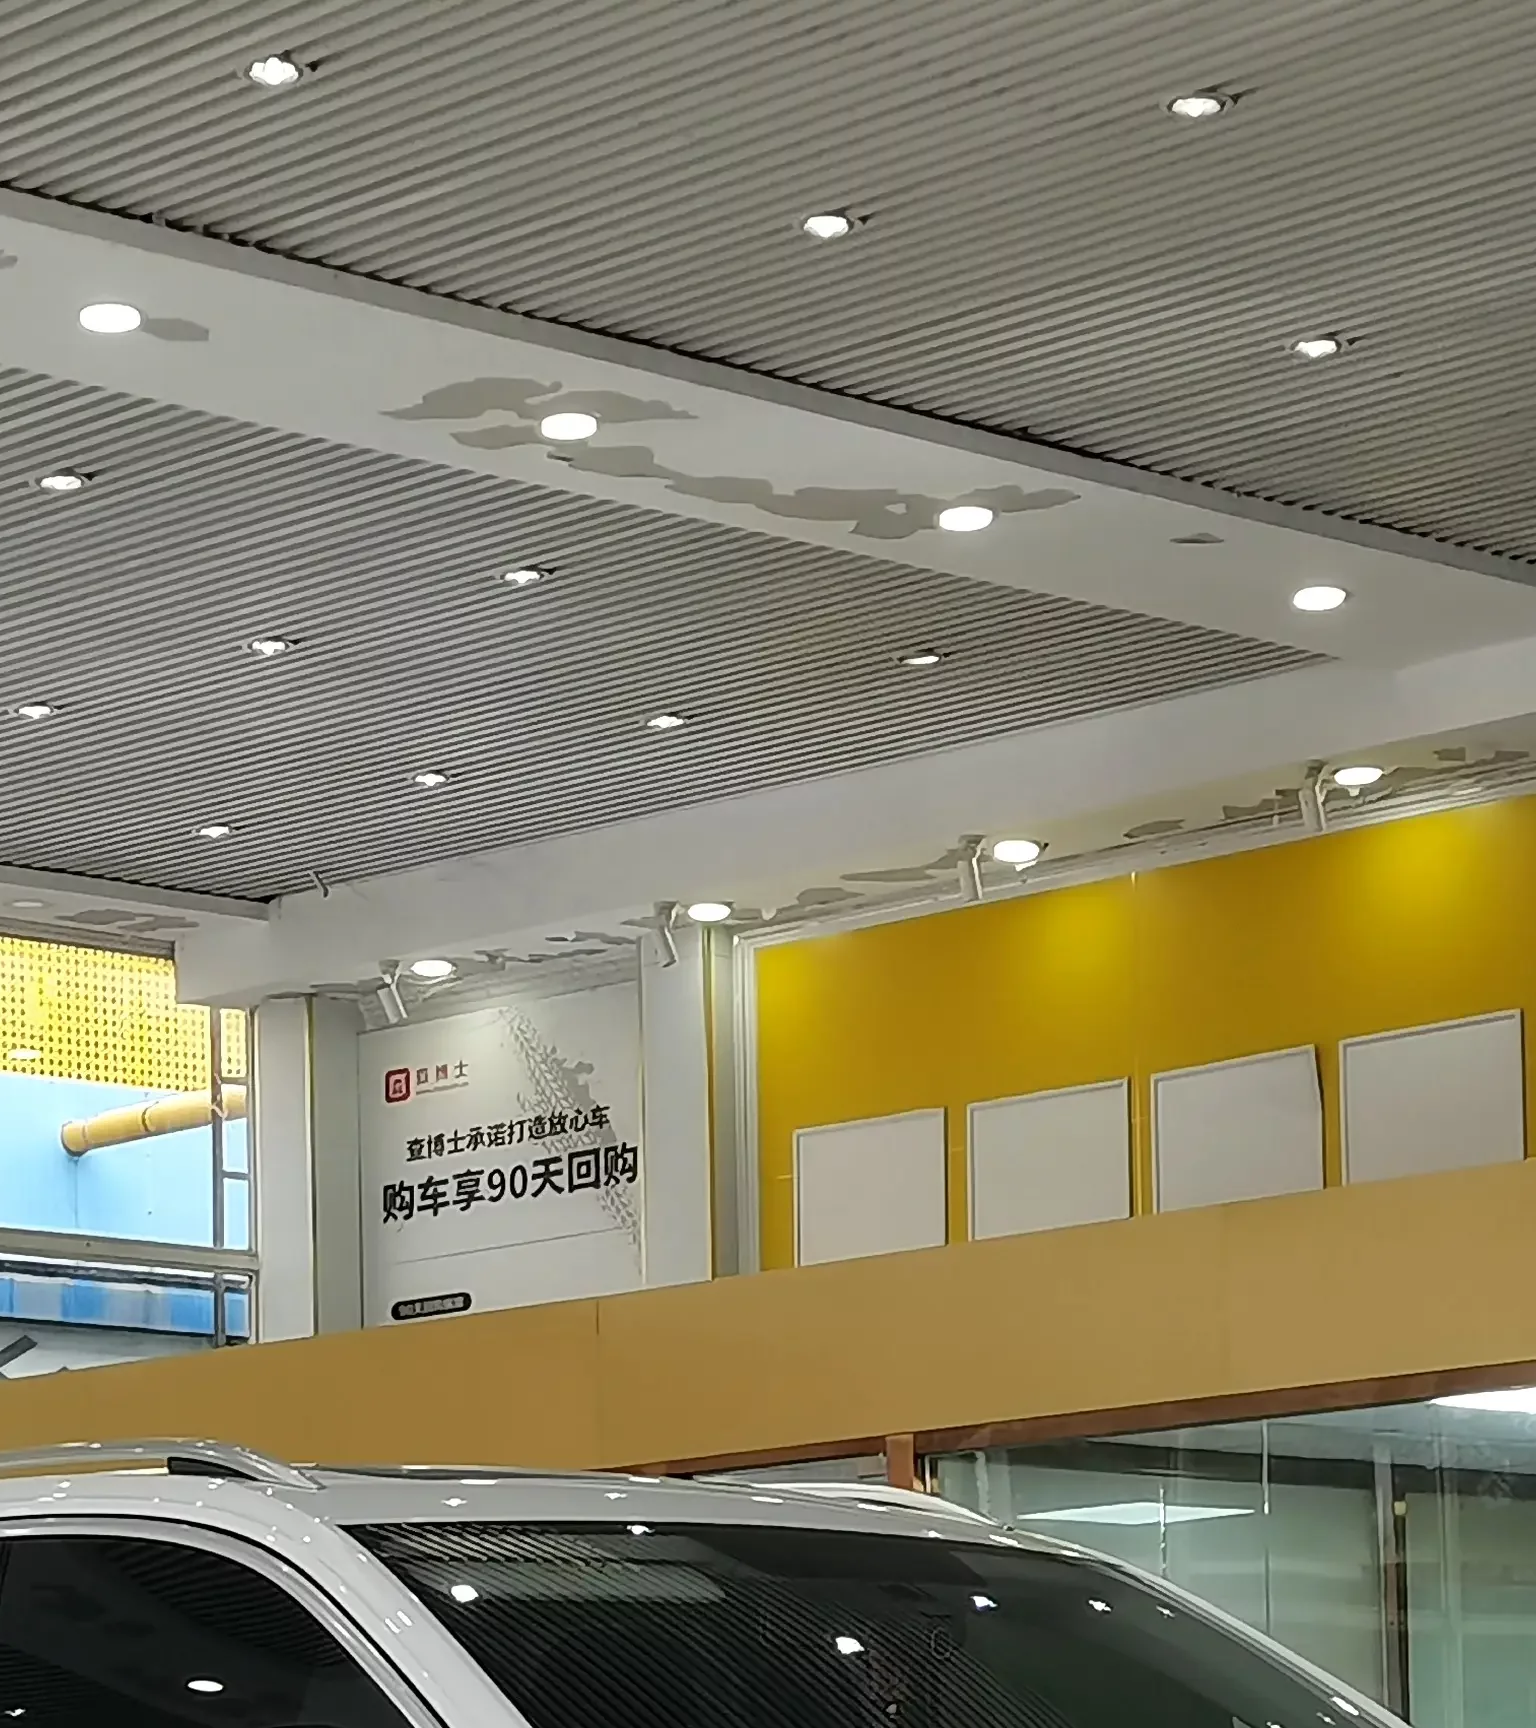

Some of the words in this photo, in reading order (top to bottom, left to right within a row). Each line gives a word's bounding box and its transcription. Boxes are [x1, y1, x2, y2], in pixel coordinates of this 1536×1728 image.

[407, 1104, 611, 1162] 查博士承诺打造放心车
[382, 1141, 639, 1224] 购车享90天回购
